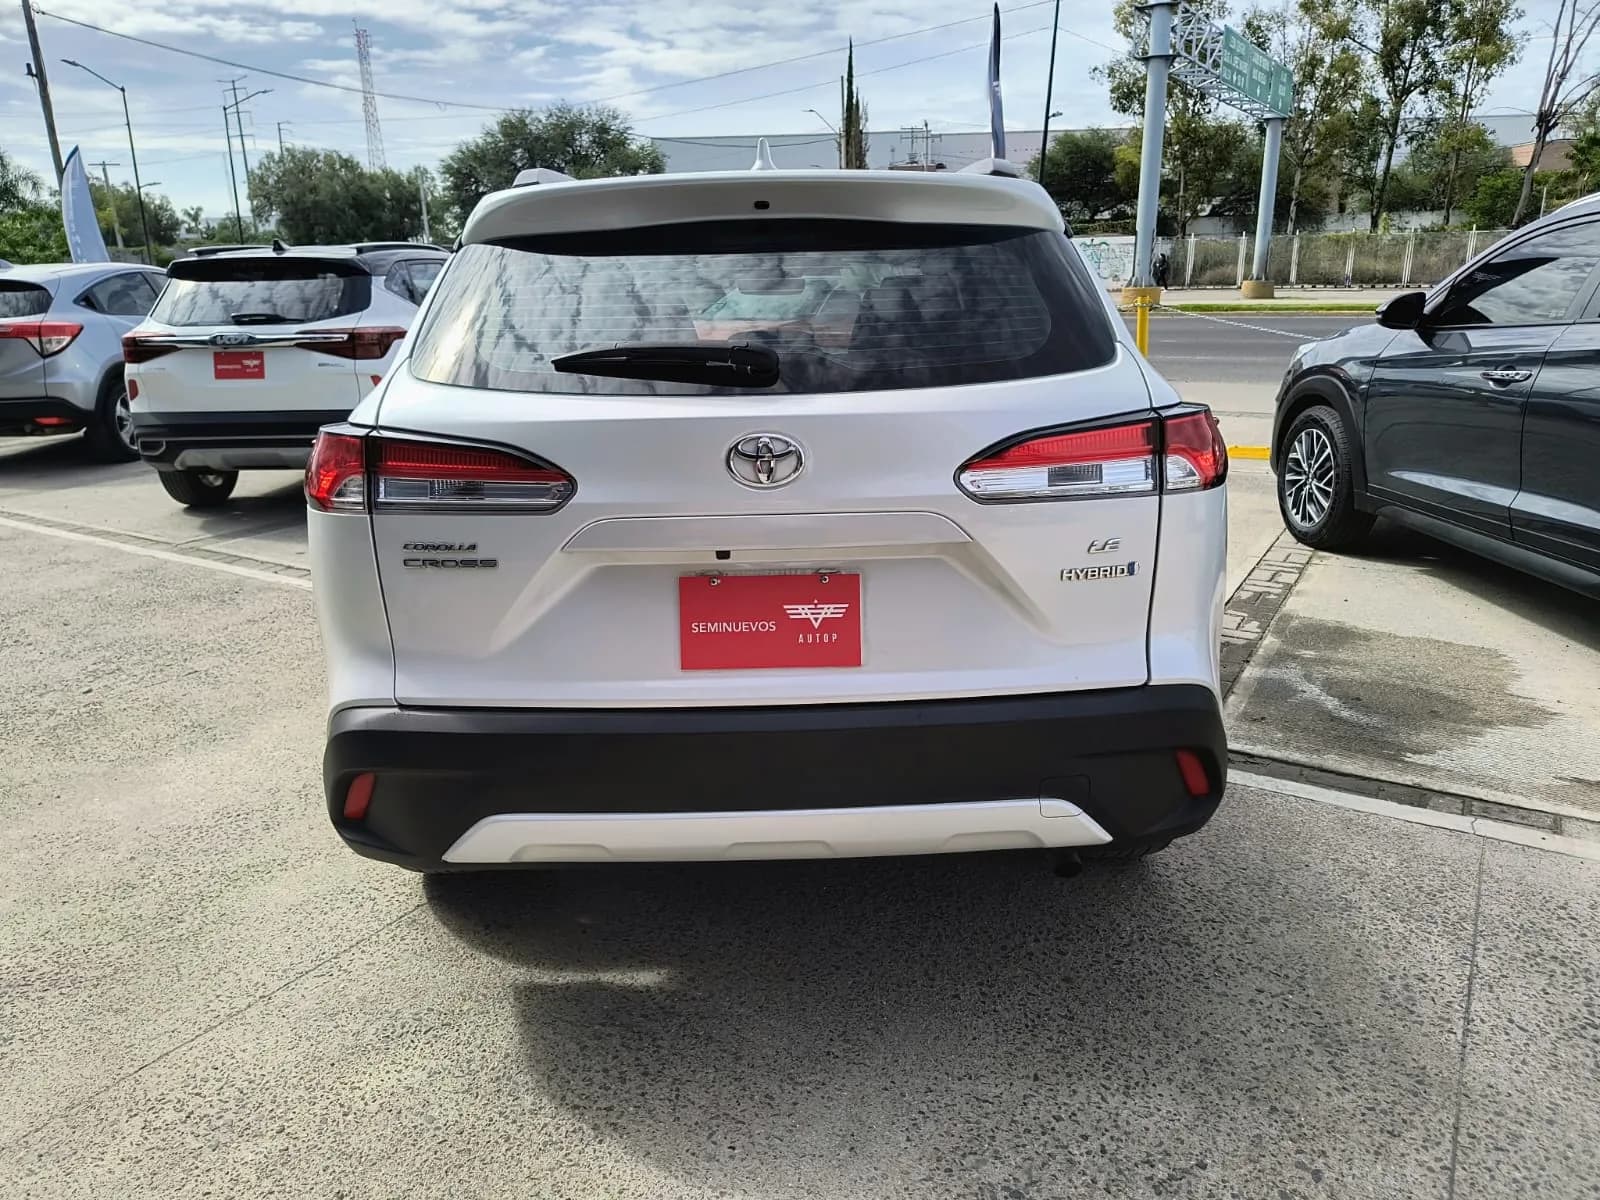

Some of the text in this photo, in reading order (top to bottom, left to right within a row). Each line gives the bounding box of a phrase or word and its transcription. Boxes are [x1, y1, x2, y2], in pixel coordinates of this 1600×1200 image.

[402, 543, 478, 553] COROLLA
[1086, 537, 1121, 554] LE
[403, 559, 499, 569] CROSS
[1060, 564, 1129, 581] HYBRID
[691, 621, 777, 633] SEMINUEVOS
[798, 633, 838, 644] AUTOP
